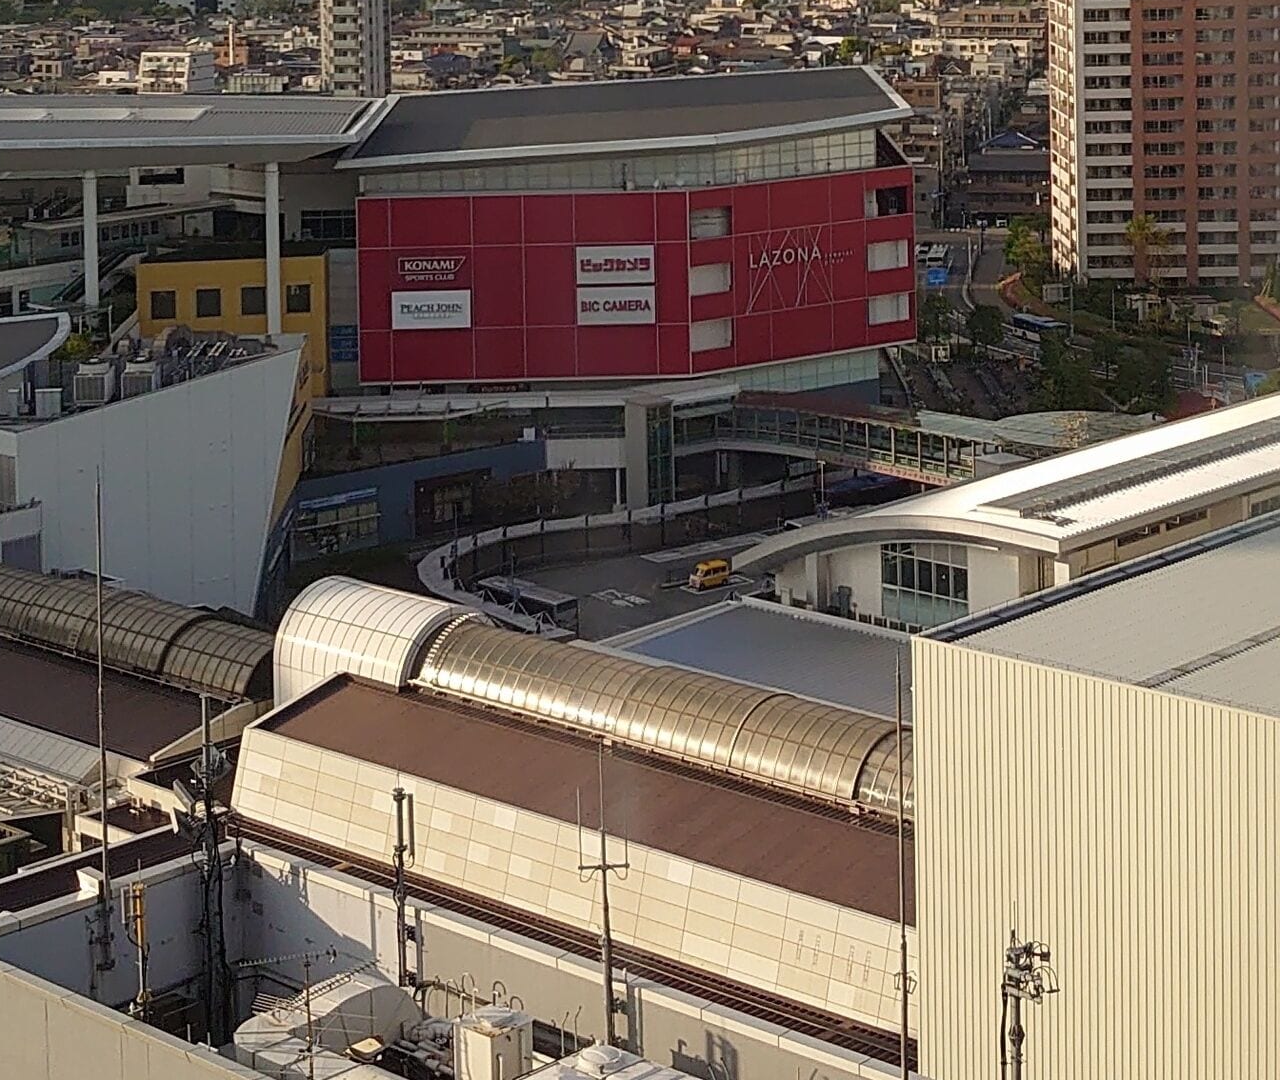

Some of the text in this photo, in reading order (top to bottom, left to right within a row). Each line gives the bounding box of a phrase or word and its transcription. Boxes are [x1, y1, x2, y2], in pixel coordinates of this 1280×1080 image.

[749, 246, 821, 269] LAZONA
[404, 260, 455, 271] KONAMI
[434, 273, 455, 281] CLUB
[401, 303, 463, 314] PEACH JOHN
[581, 300, 651, 312] BIC CAMERA
